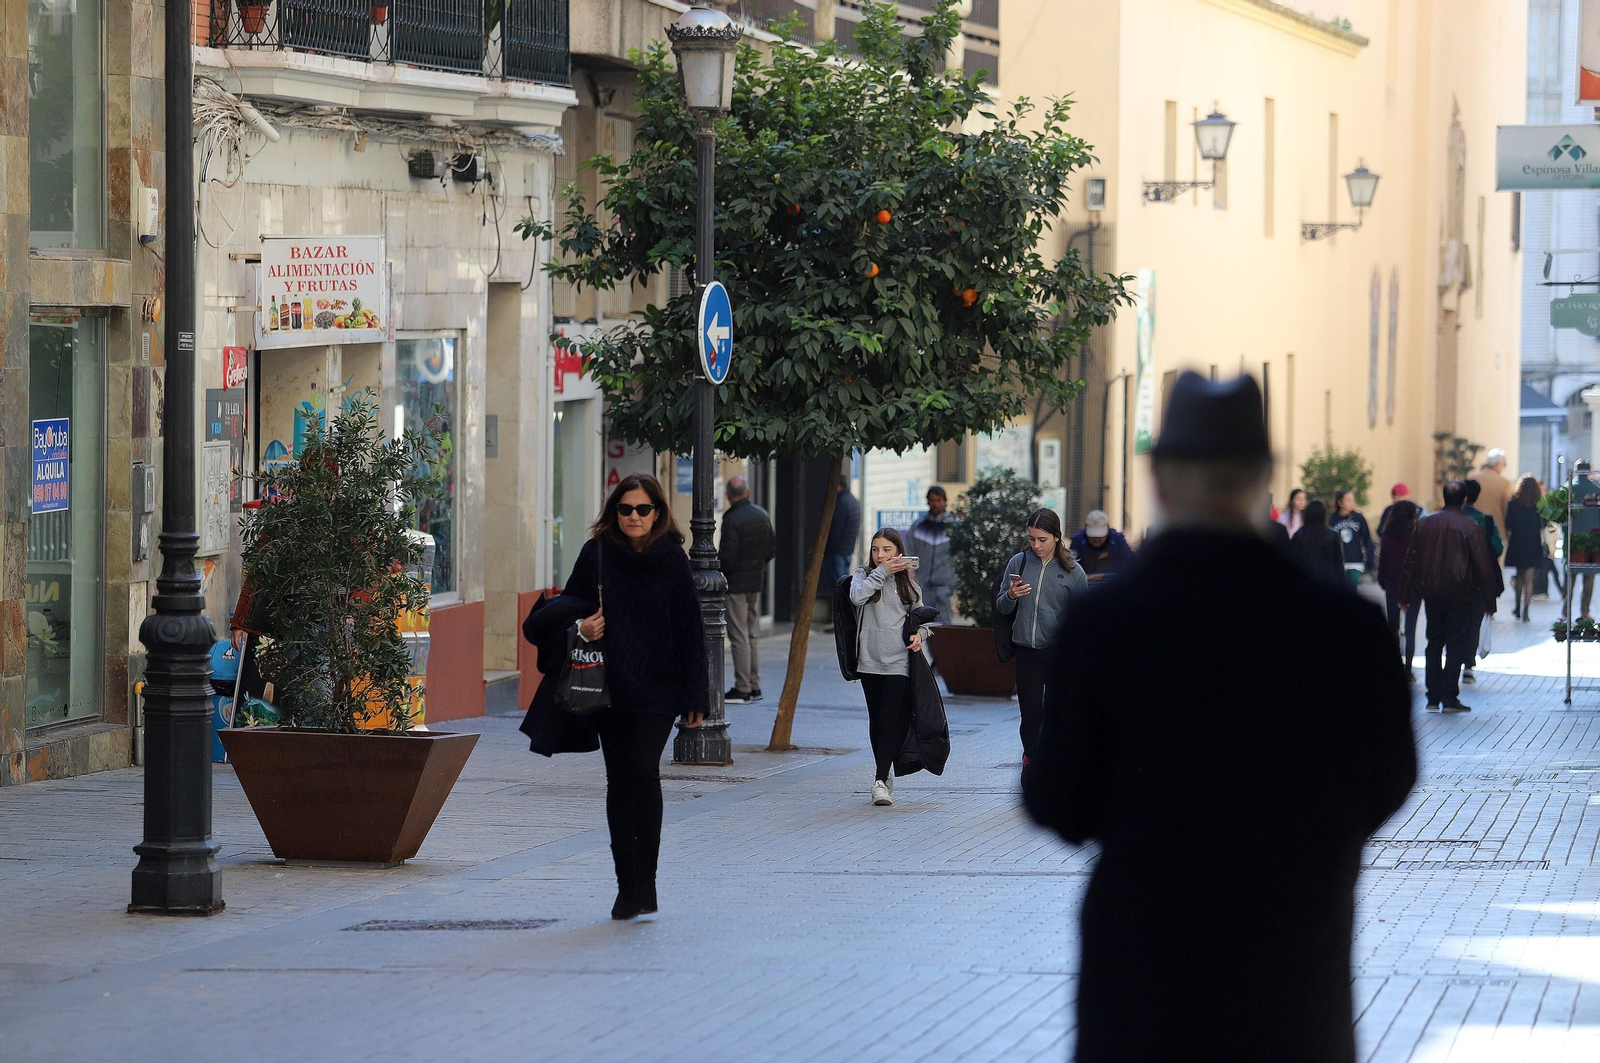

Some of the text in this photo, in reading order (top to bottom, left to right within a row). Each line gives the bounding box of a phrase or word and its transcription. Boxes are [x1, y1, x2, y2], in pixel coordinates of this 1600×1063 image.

[290, 246, 348, 260] BAZAR
[267, 259, 375, 278] ALIMENTACIÓN
[284, 279, 358, 292] Y FRUTAS
[36, 461, 65, 481] ALQUILA
